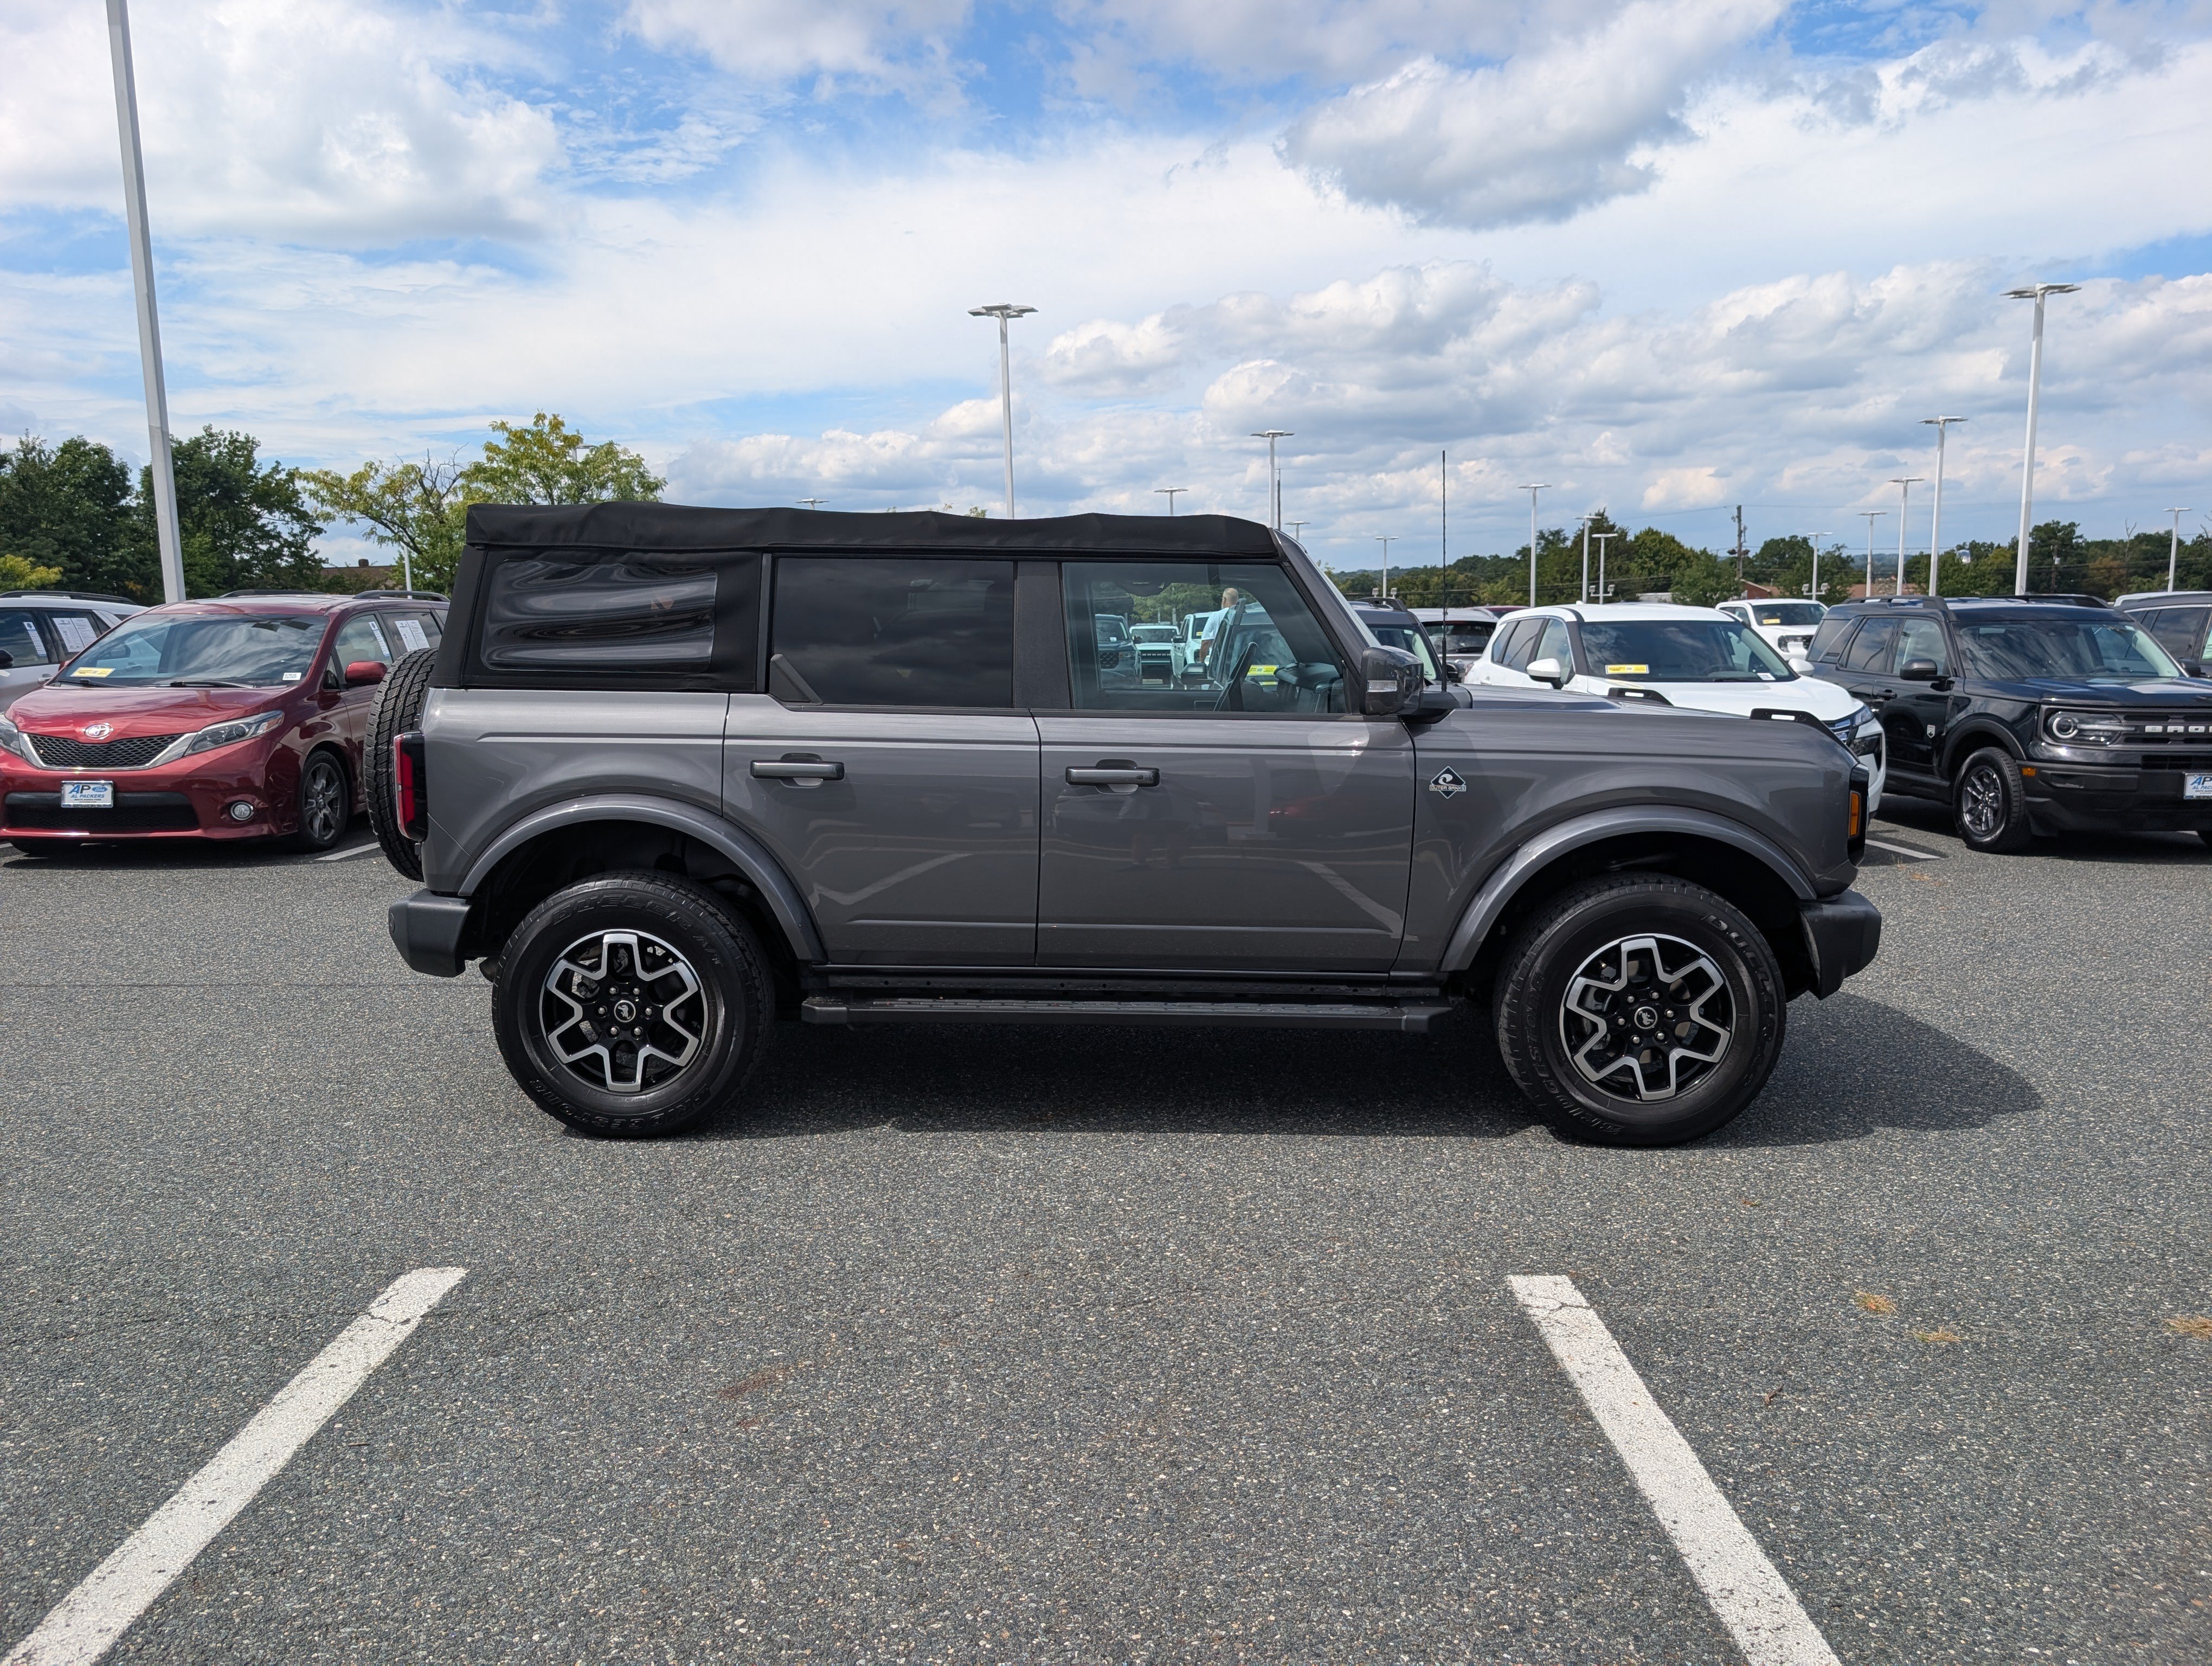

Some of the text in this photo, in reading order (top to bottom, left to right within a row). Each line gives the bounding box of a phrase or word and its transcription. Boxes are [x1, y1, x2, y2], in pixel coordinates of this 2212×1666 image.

[68, 785, 91, 794] AP
[551, 893, 693, 931] DUELER
[1700, 913, 1777, 1042] DUELER
[1524, 970, 1625, 1135] BRIDGESTONE
[529, 1077, 711, 1130] BRIDGESTONE
